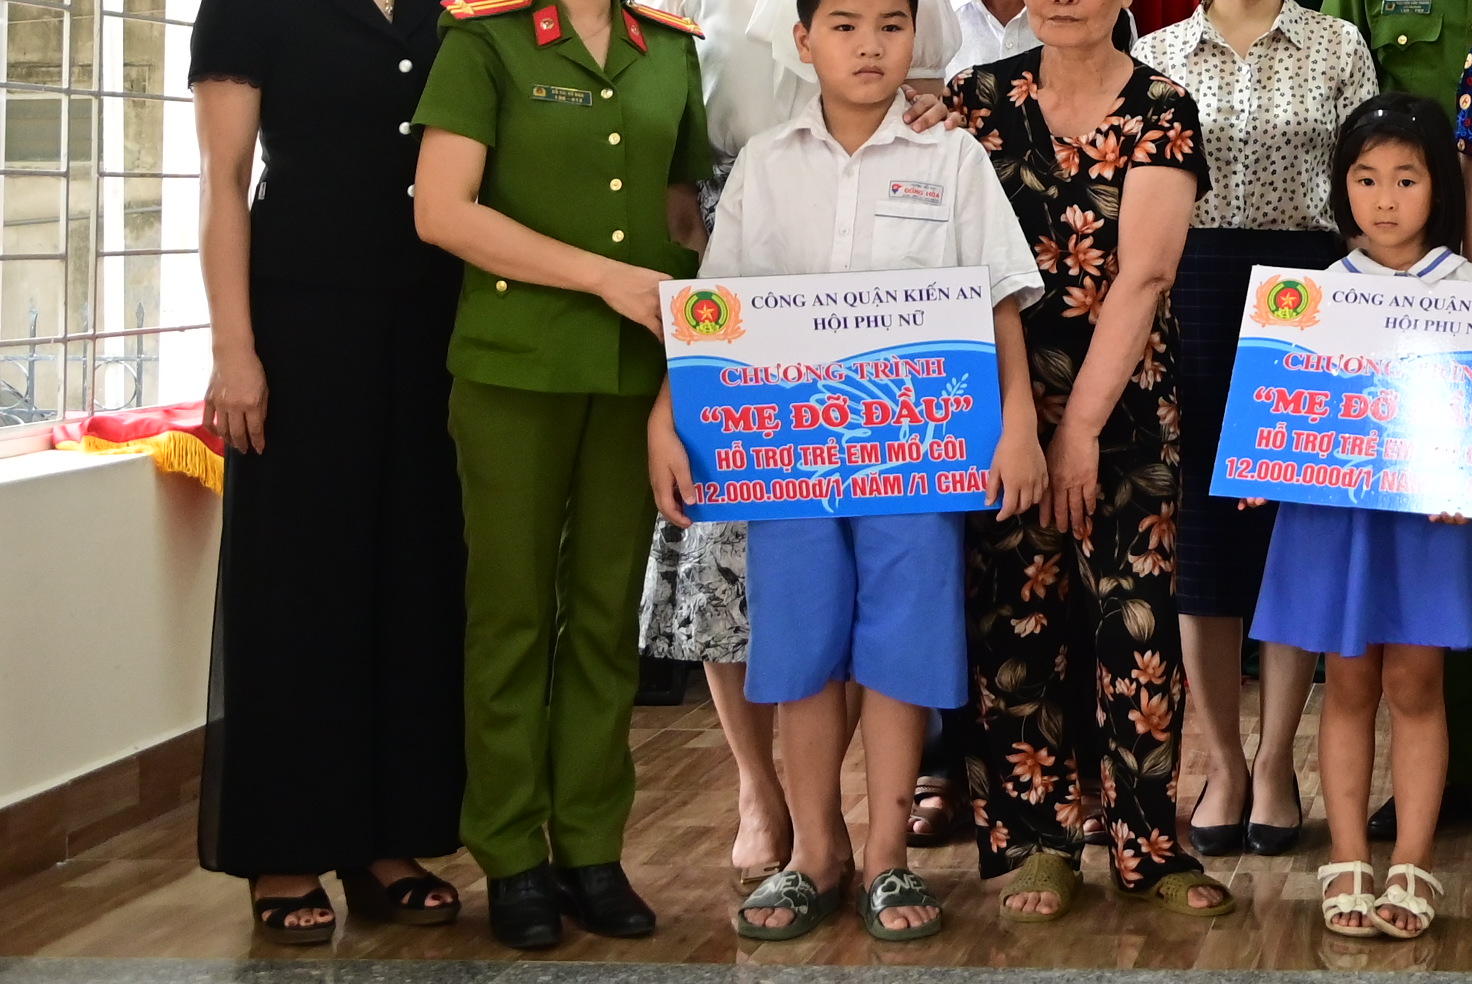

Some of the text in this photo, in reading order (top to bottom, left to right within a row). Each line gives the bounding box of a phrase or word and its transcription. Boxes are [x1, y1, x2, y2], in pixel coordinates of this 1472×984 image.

[751, 281, 983, 309] CÔNG AN QUẬN KIẾN AN
[1332, 289, 1384, 307] CÔNG
[1389, 294, 1414, 308] AN
[1419, 293, 1472, 316] QUẬN
[812, 309, 925, 333] HỘI PHỤ NỮ
[1384, 314, 1418, 332] HỘI
[1423, 319, 1461, 337] PHỤ
[720, 354, 946, 387] CHƯƠNG TRÌNH
[1283, 352, 1402, 378] CHƯƠNG
[700, 385, 973, 438] “MẸ ĐỠ ĐẦU”
[1253, 386, 1331, 423] “MẸ
[1338, 389, 1401, 423] ĐỠ
[716, 440, 748, 471] HỖ
[752, 444, 795, 473] TRỢ
[799, 437, 841, 467] TRẺ
[845, 442, 881, 466] EM
[929, 435, 967, 462] CÔI
[1256, 422, 1287, 450] HỖ
[1292, 430, 1336, 458] TRỢ
[1339, 430, 1379, 458] TRẺ
[693, 476, 843, 505] 12.000.000đ/1
[851, 471, 904, 498] NĂM
[908, 472, 928, 496] /1
[1225, 457, 1373, 490] 12.000.000đ/1
